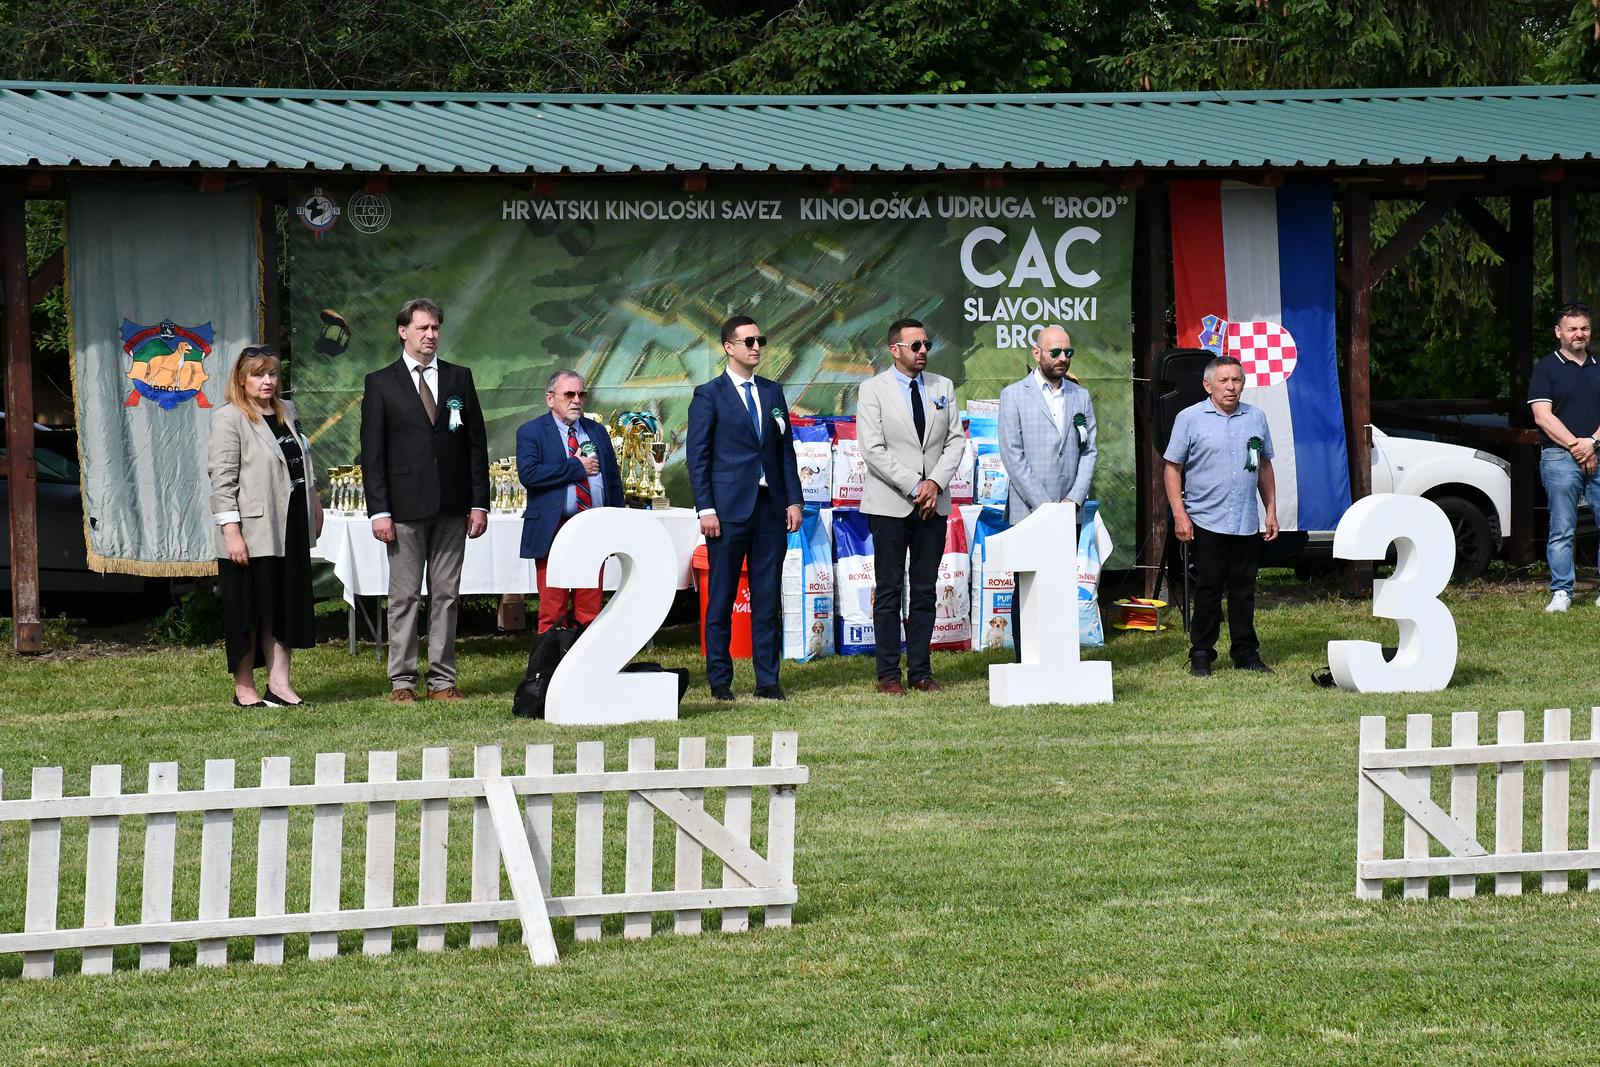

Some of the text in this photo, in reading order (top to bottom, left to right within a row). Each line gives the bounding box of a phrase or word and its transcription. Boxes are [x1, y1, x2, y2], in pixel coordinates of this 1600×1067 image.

[362, 207, 378, 215] FCI
[502, 194, 782, 220] HRVATSKI KINOLOŠKI SAVEZ
[800, 192, 932, 220] KINOLOŠKA
[938, 196, 1036, 218] UDRUGA
[960, 226, 1102, 288] CAC
[964, 297, 1098, 322] SLAVONSKI
[996, 324, 1064, 348] BRO
[987, 501, 1113, 706] 1
[1328, 495, 1457, 694] 3
[545, 507, 678, 725] 2
